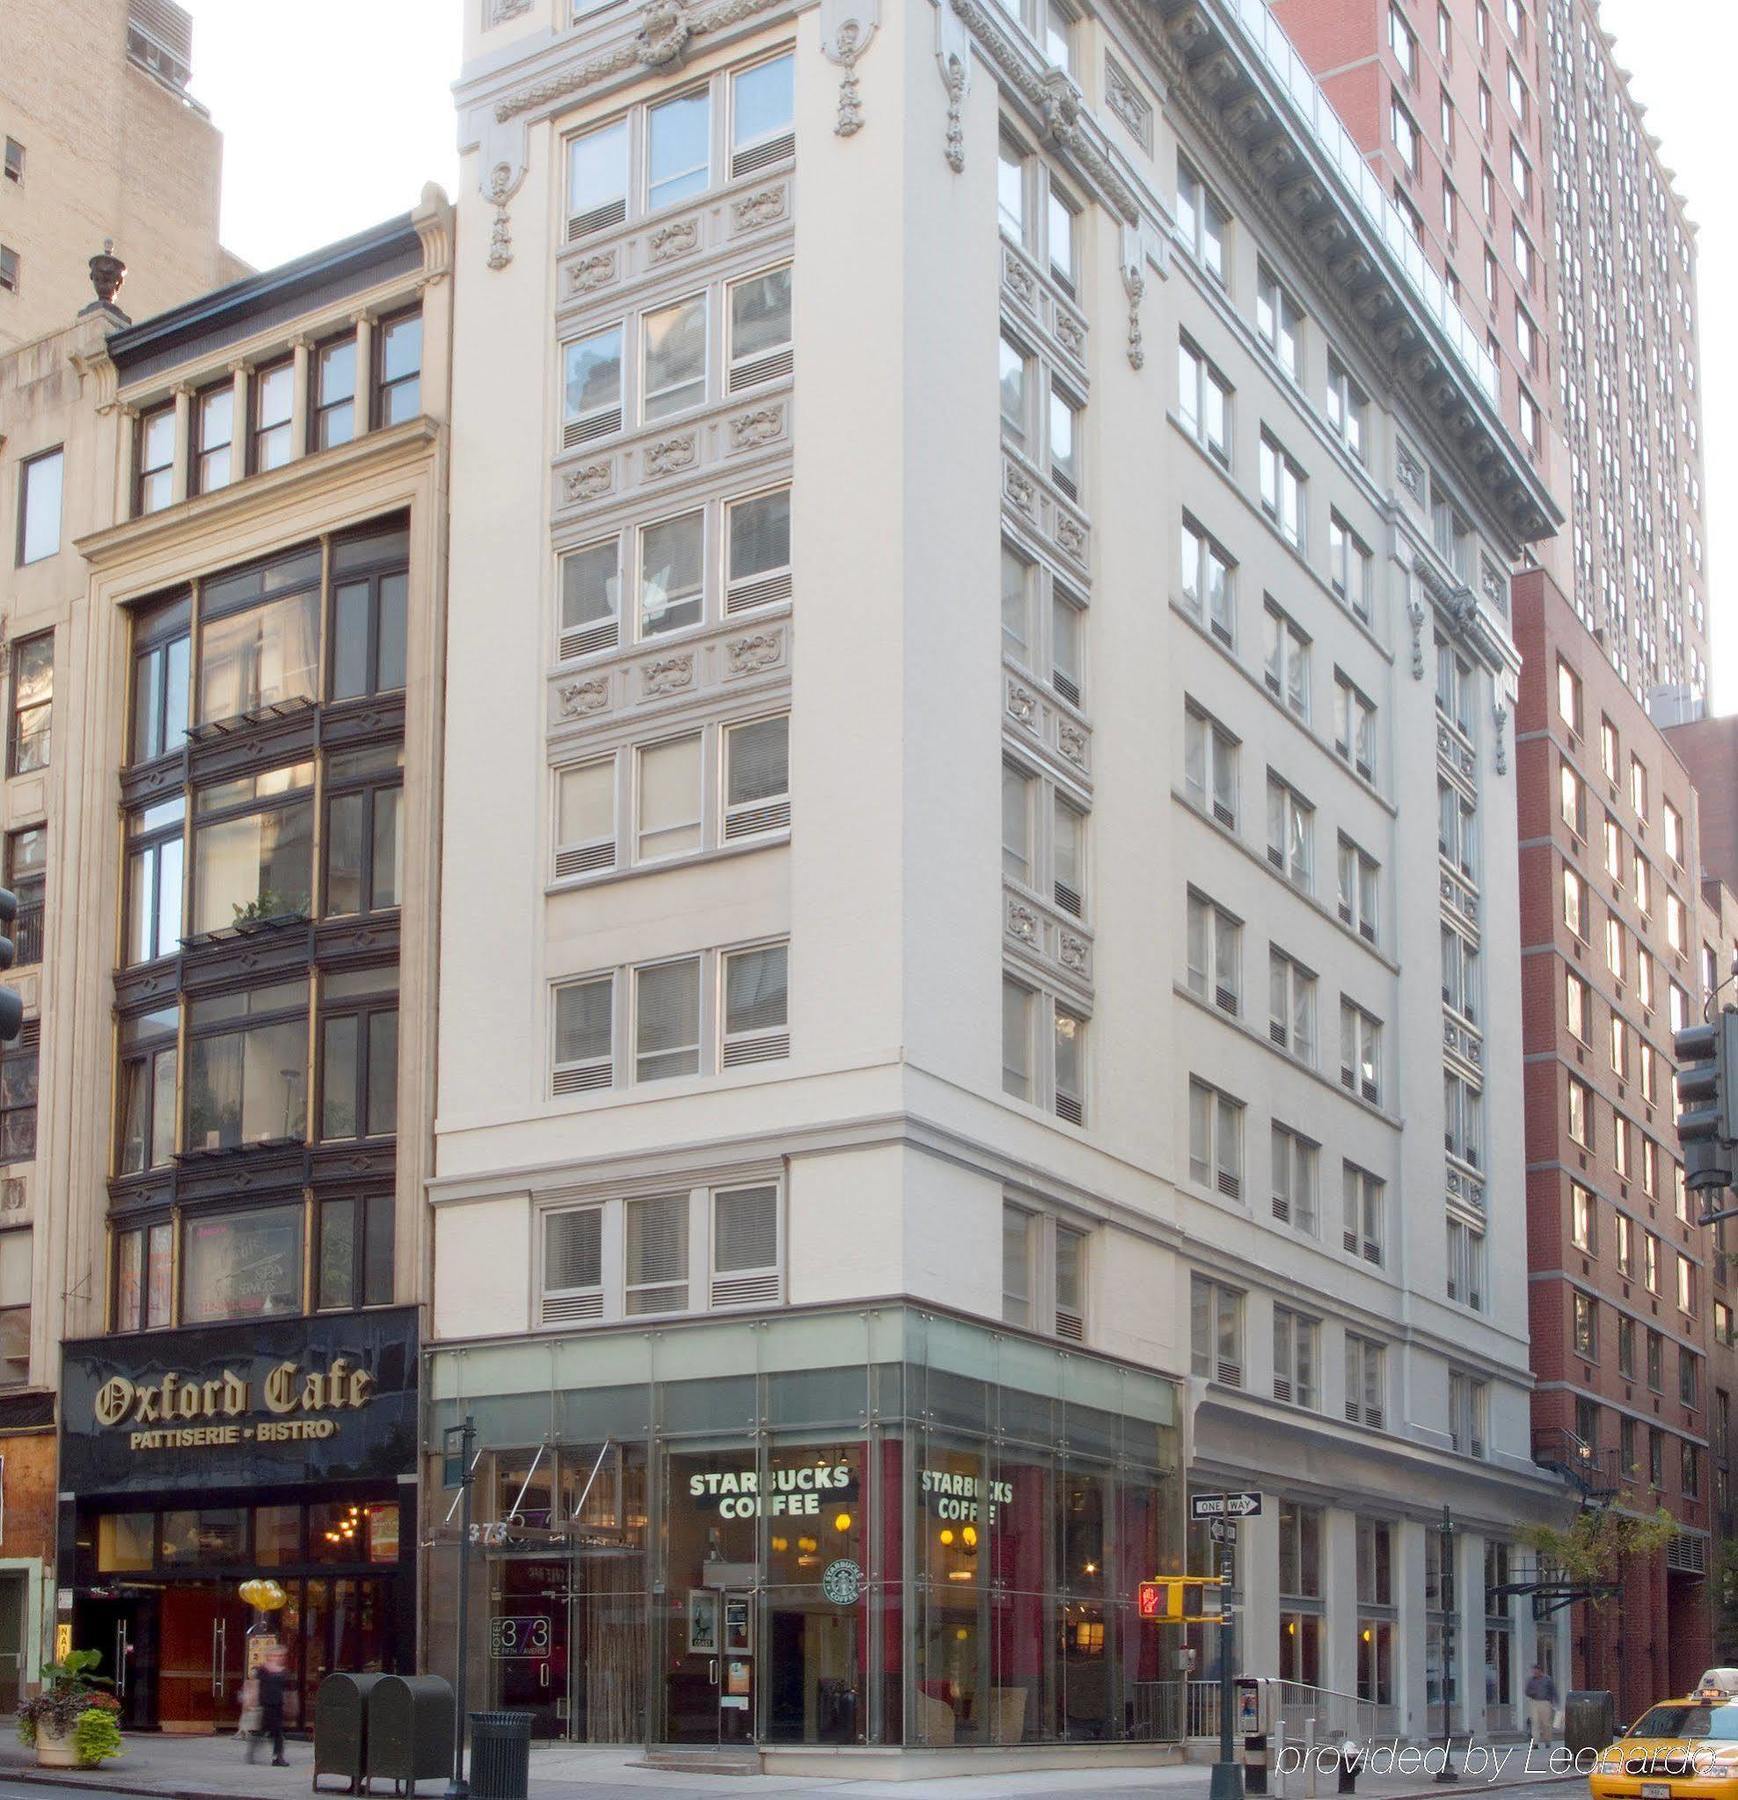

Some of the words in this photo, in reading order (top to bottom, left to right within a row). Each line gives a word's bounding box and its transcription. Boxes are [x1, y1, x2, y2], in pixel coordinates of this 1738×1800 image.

[95, 1369, 250, 1426] Oxford
[264, 1358, 375, 1413] Cafe
[131, 1426, 241, 1450] PATTISERIE
[257, 1419, 338, 1442] BISTRO
[922, 1470, 1013, 1504] STARBKS
[938, 1498, 996, 1525] COFFE
[1202, 1502, 1220, 1511] ONE
[1230, 1500, 1251, 1510] WAY
[469, 1522, 507, 1543] 373
